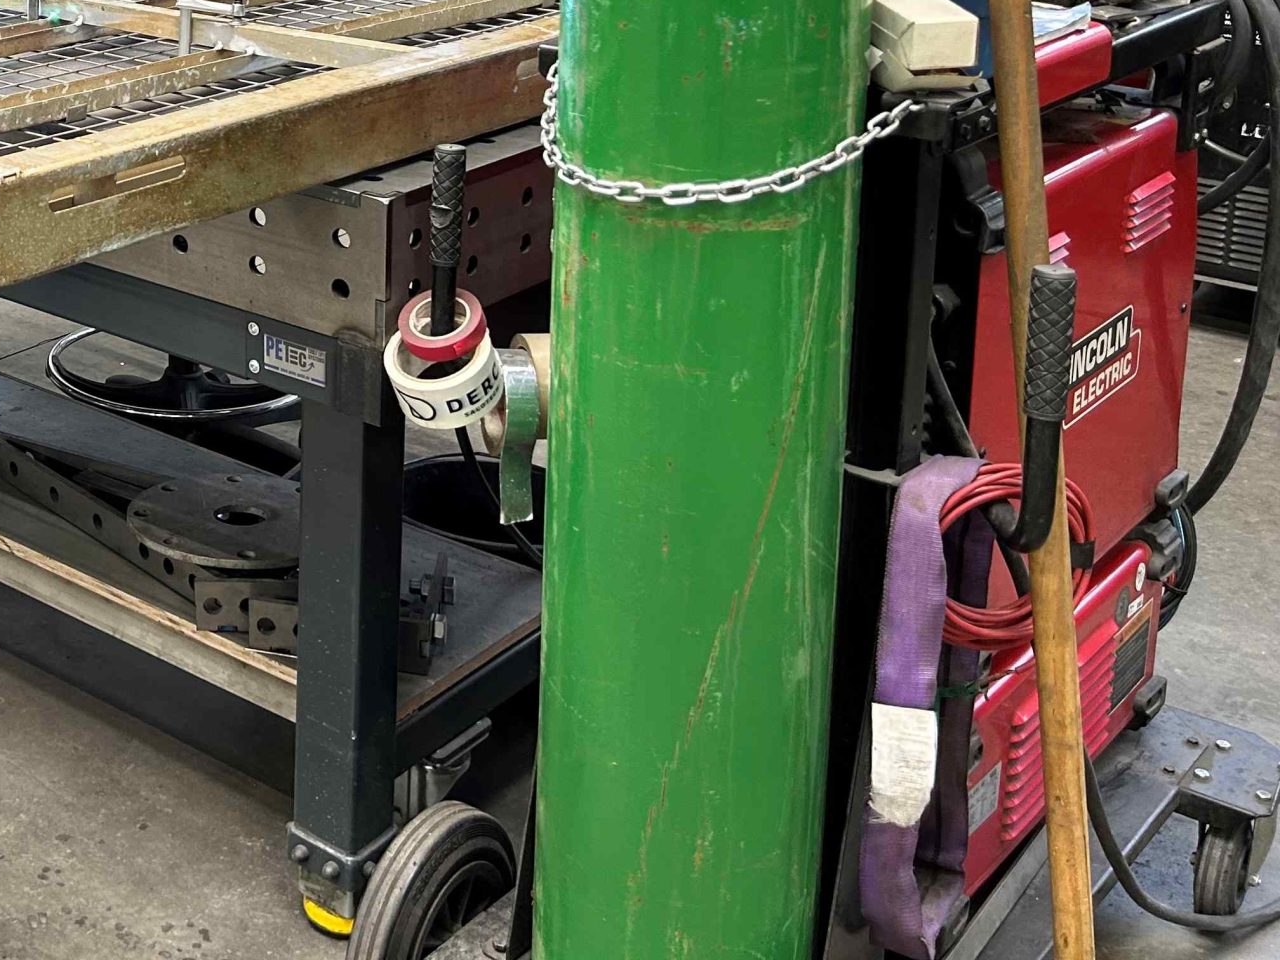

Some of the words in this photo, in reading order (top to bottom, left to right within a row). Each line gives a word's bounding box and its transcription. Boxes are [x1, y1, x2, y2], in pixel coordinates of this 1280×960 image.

[266, 336, 307, 368] PETEC
[1068, 316, 1129, 385] INCOLN
[1072, 352, 1132, 415] ELECTRIC
